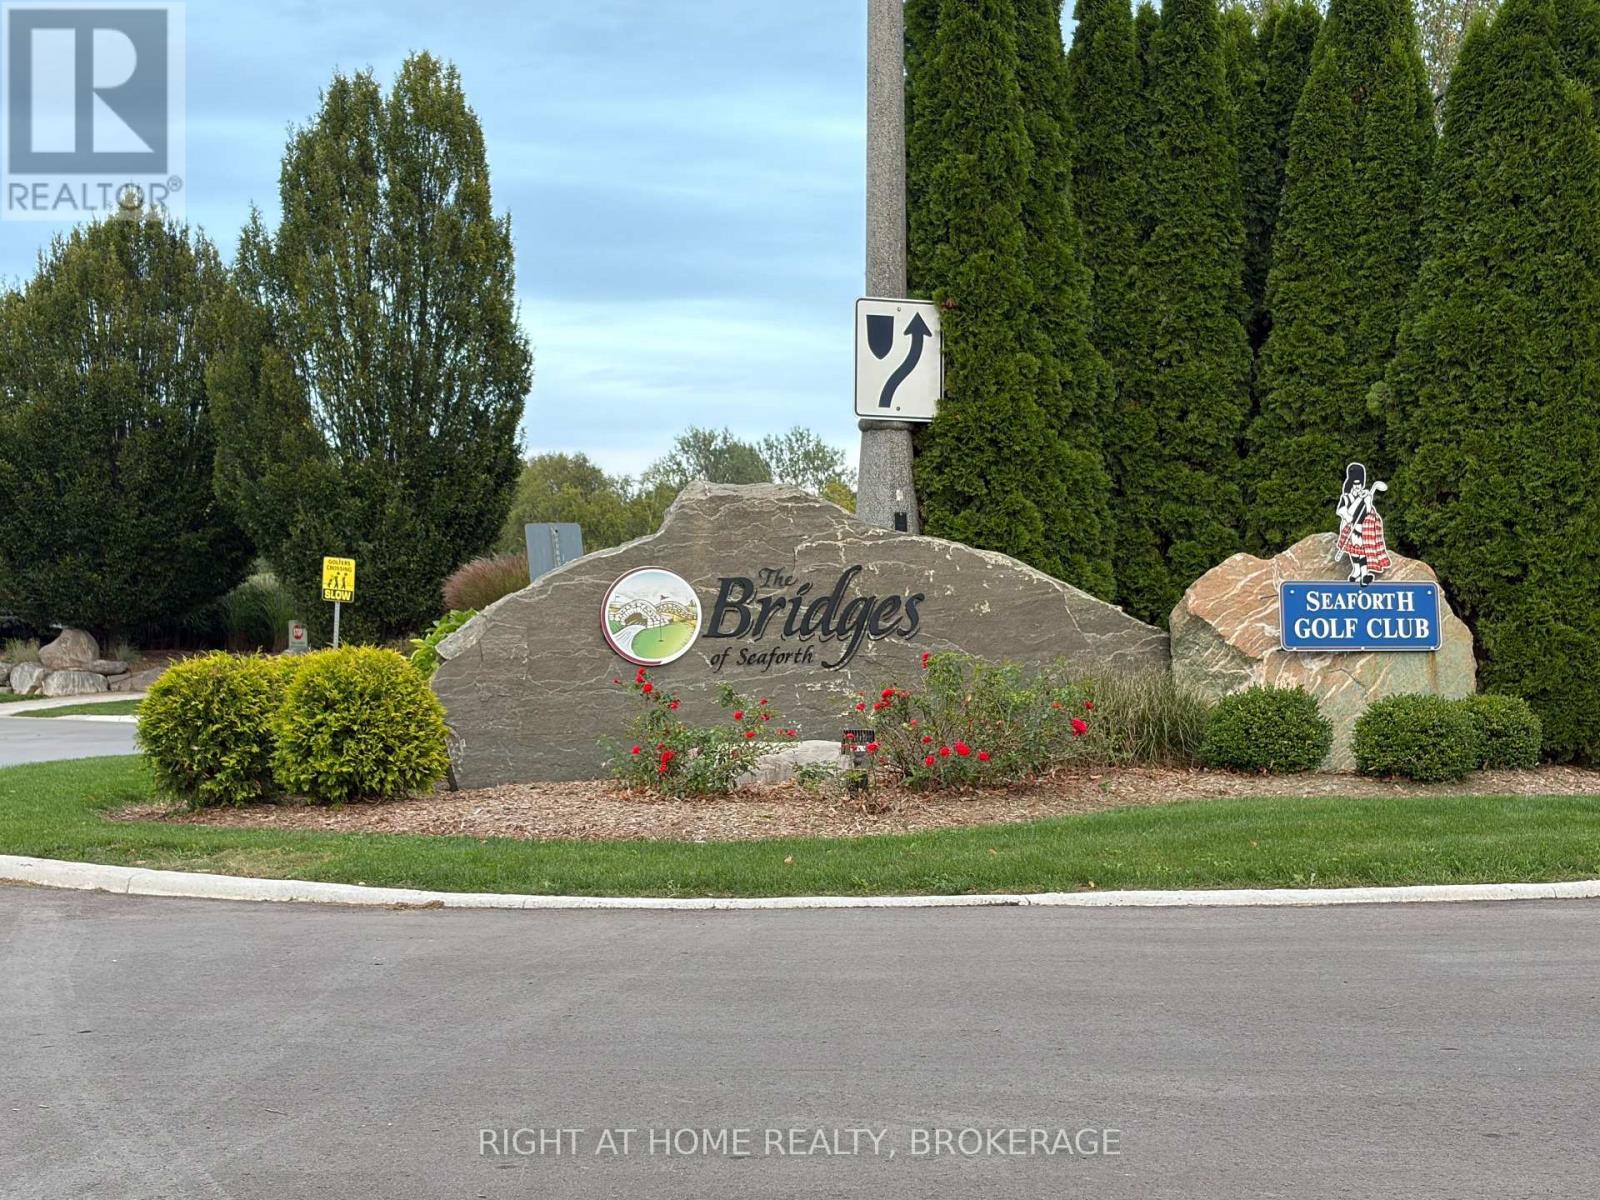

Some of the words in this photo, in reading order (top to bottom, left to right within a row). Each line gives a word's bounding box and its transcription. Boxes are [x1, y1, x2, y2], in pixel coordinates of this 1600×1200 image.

[758, 566, 796, 587] The
[324, 590, 352, 600] SLOW
[1306, 590, 1415, 612] SEAFORTH
[702, 565, 925, 669] Bridges
[1294, 618, 1358, 639] GOLF
[1366, 618, 1429, 639] CLUB
[710, 648, 730, 673] of
[735, 644, 814, 672] Seaforth
